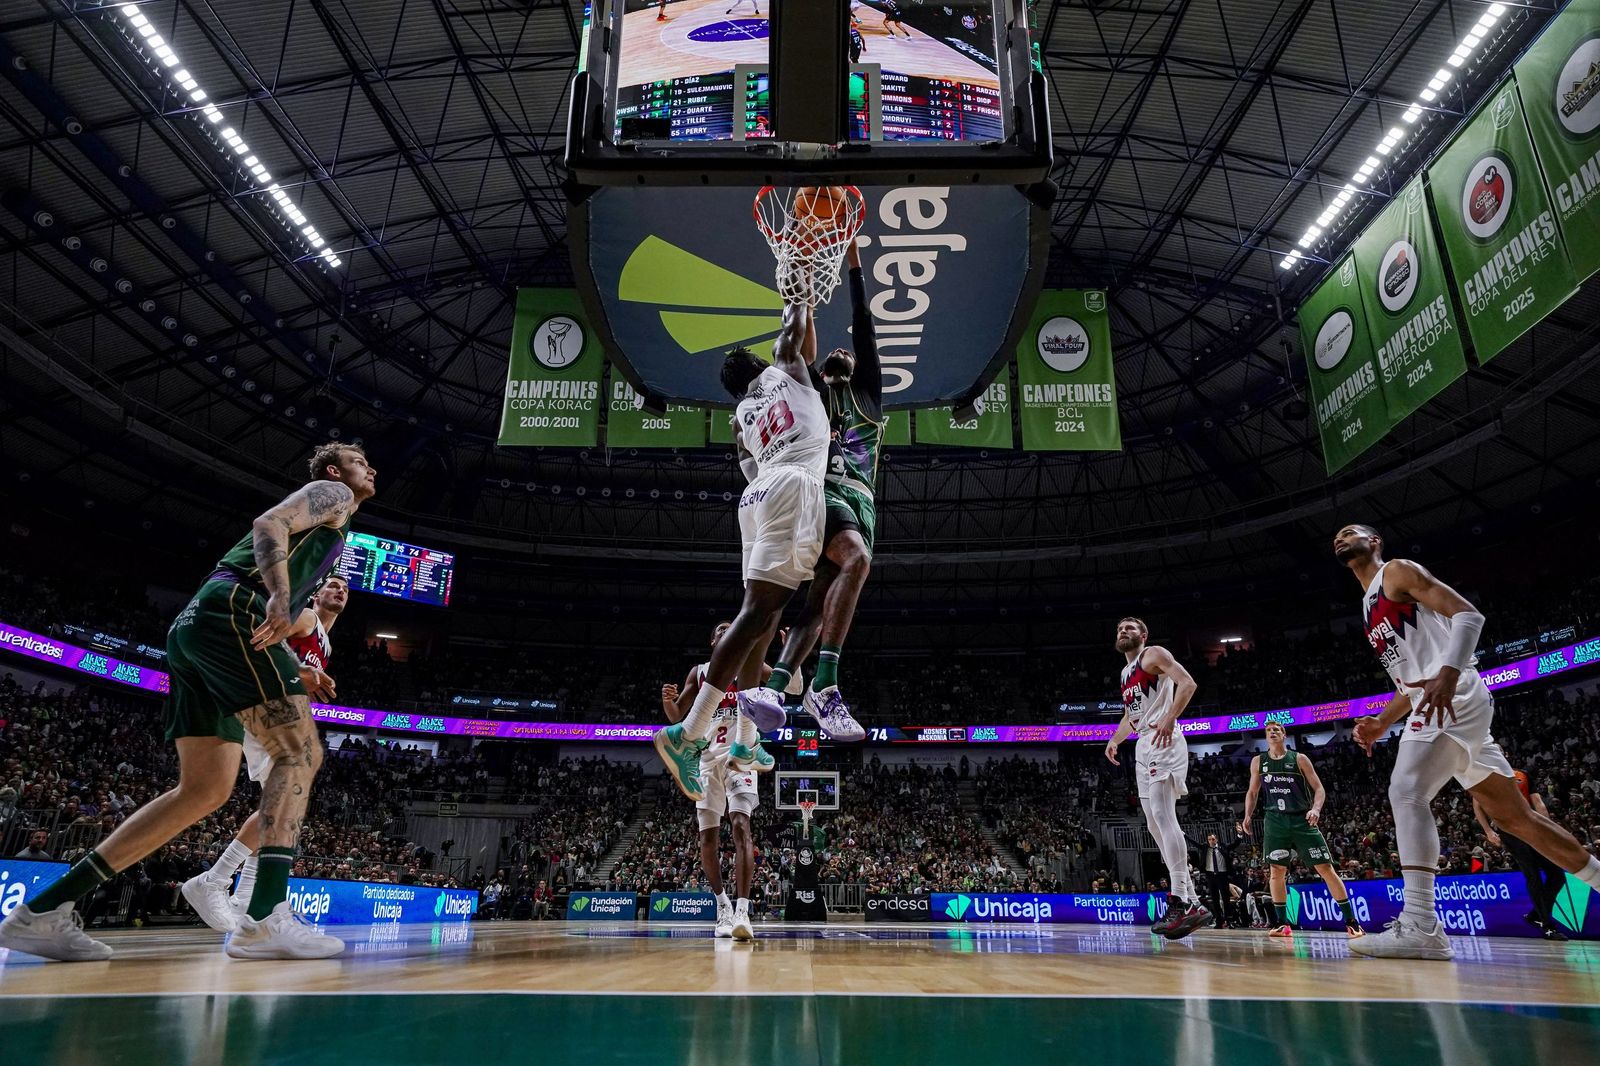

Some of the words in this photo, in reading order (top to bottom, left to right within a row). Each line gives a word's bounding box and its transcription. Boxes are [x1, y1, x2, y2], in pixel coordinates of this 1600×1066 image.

[686, 84, 732, 94] SULEJMANOVIC
[686, 106, 712, 114] DUARTE
[686, 127, 707, 135] PERRY
[1464, 211, 1556, 304] CAMPEONES
[1471, 286, 1500, 317] COPA
[1503, 268, 1527, 290] DEL
[1532, 236, 1557, 265] REY
[1504, 288, 1535, 322] 2025
[1378, 295, 1448, 370] CAMPEONES
[1384, 319, 1452, 384] SUPERCOPA
[1407, 360, 1433, 388] 2024
[508, 380, 598, 400] CAMPEONES
[1023, 384, 1112, 402] CAMPEONES
[1318, 362, 1376, 424] CAMPEONES
[510, 400, 544, 410] COPA
[548, 400, 592, 411] KORAC
[1057, 408, 1083, 418] BCL
[520, 416, 580, 428] 2000/2001
[642, 418, 671, 430] 2005
[1055, 421, 1085, 432] 2024
[1342, 418, 1362, 442] 2024
[831, 455, 845, 474] 3
[380, 542, 390, 550] 76
[396, 544, 404, 552] VS
[410, 548, 420, 556] 74
[389, 564, 408, 574] 7:57
[716, 726, 728, 743] 2
[777, 729, 792, 740] 76
[871, 728, 888, 740] 74
[798, 740, 818, 750] 2.8
[1278, 798, 1286, 810] 9
[363, 886, 385, 900] Partido
[386, 887, 410, 900] dedicado
[796, 890, 814, 900] Risi
[1500, 884, 1510, 900] a
[445, 895, 471, 919] Unicaja
[591, 897, 632, 905] Fundación
[672, 898, 713, 906] Fundación
[867, 895, 928, 912] endesa
[1074, 897, 1113, 907] Partido
[374, 902, 402, 920] Unicaja
[590, 905, 620, 914] Unicaja
[672, 906, 702, 914] Unicaja
[974, 898, 1052, 922] Unicaja
